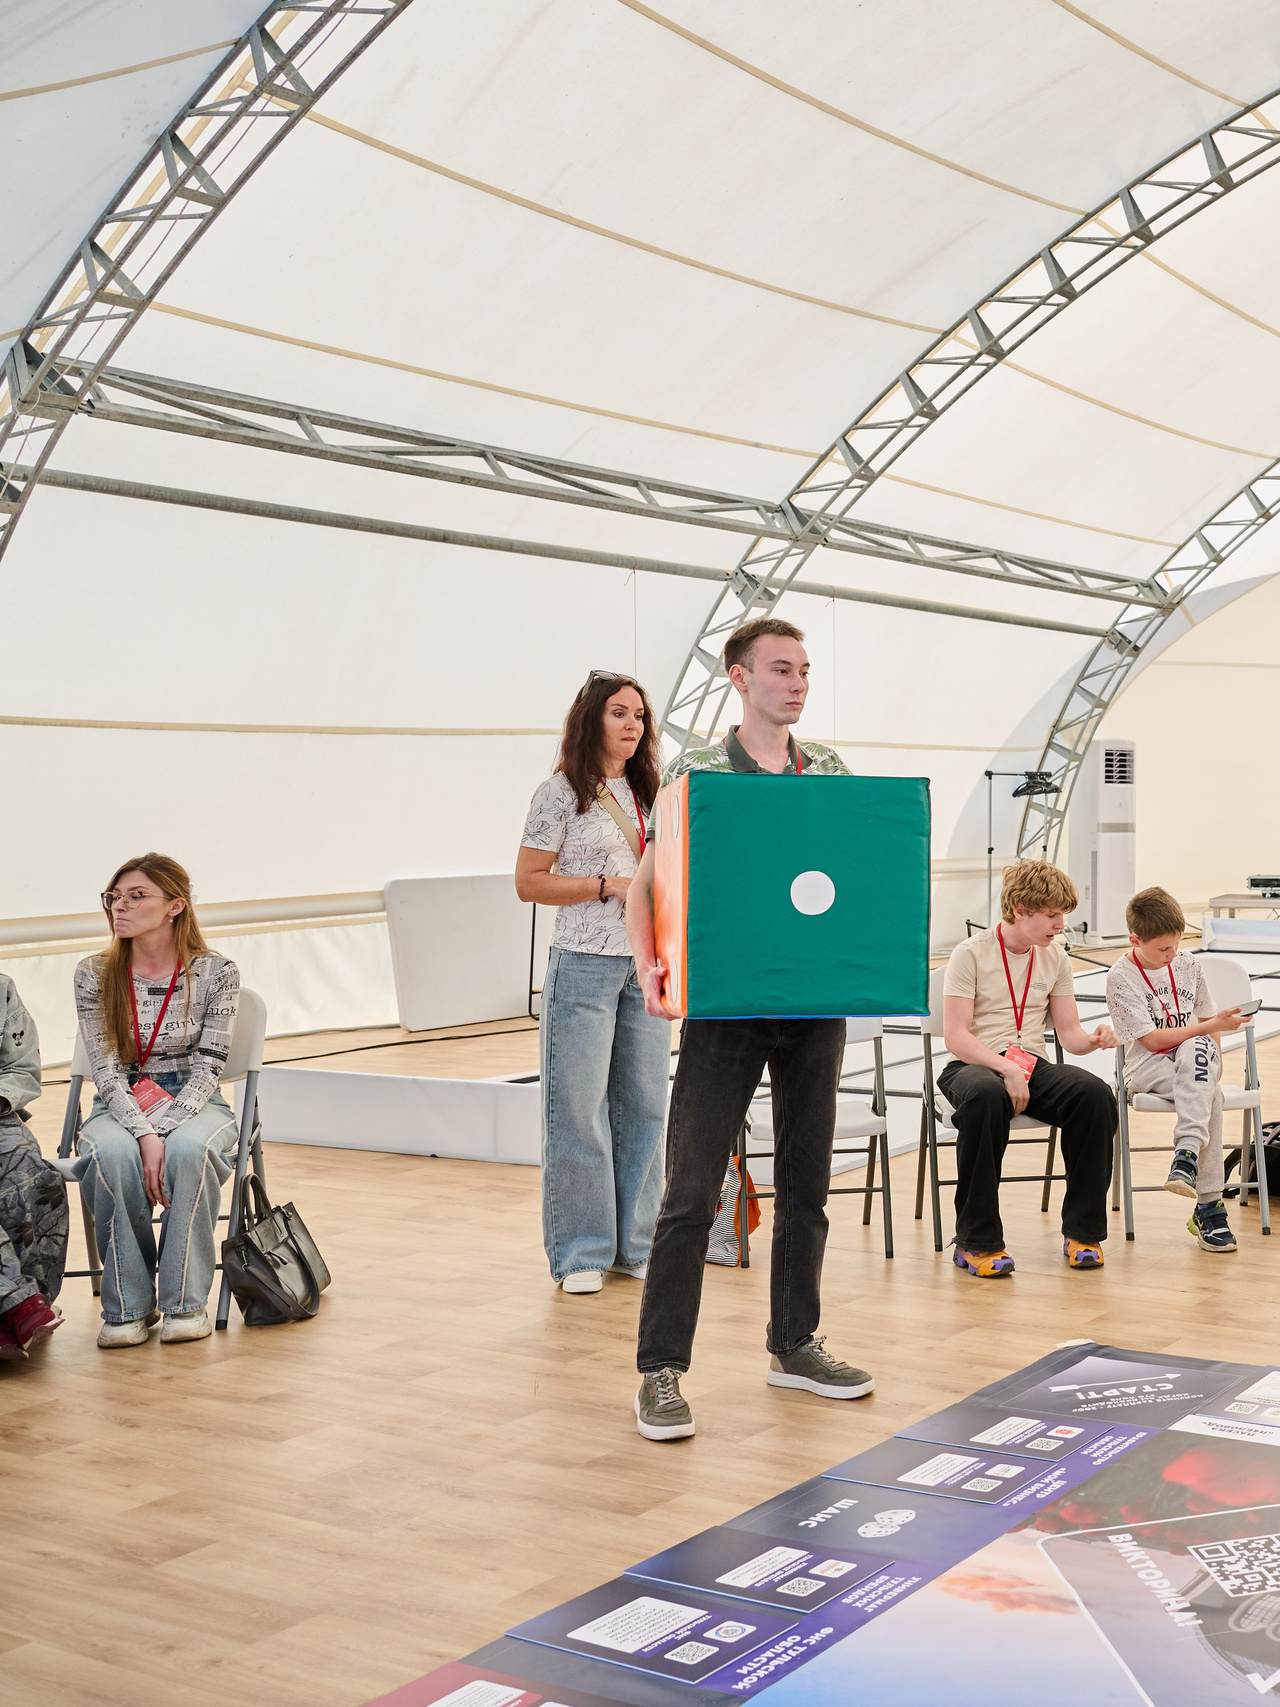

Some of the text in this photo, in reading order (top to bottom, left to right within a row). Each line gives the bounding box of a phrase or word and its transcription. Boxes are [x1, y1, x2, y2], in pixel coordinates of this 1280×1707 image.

[1076, 1383, 1174, 1400] СТАРТ!
[1081, 1435, 1114, 1455] ОБЛАСТИ
[1090, 1436, 1128, 1457] ТУЛЬСКОЙ
[1211, 1427, 1255, 1436] ПАСЕКА
[1092, 1430, 1148, 1466] ПРАВИТЕЛЬСТВО
[1002, 1468, 1066, 1507] «МОЙ БИЗНЕС»
[1036, 1480, 1067, 1498] ЦЕНТР
[798, 1498, 859, 1528] ШАНС
[841, 1574, 890, 1604] БРЕНДОВ
[853, 1574, 906, 1609] ТУЛЬСКИХ
[862, 1576, 921, 1614] УНИВЕРМАГ
[1106, 1533, 1204, 1627] ВИКТОРИНА!
[731, 1627, 834, 1689] ФНС ТУЛЬСКОЙ
[736, 1635, 801, 1674] ОБЛАСТИ
